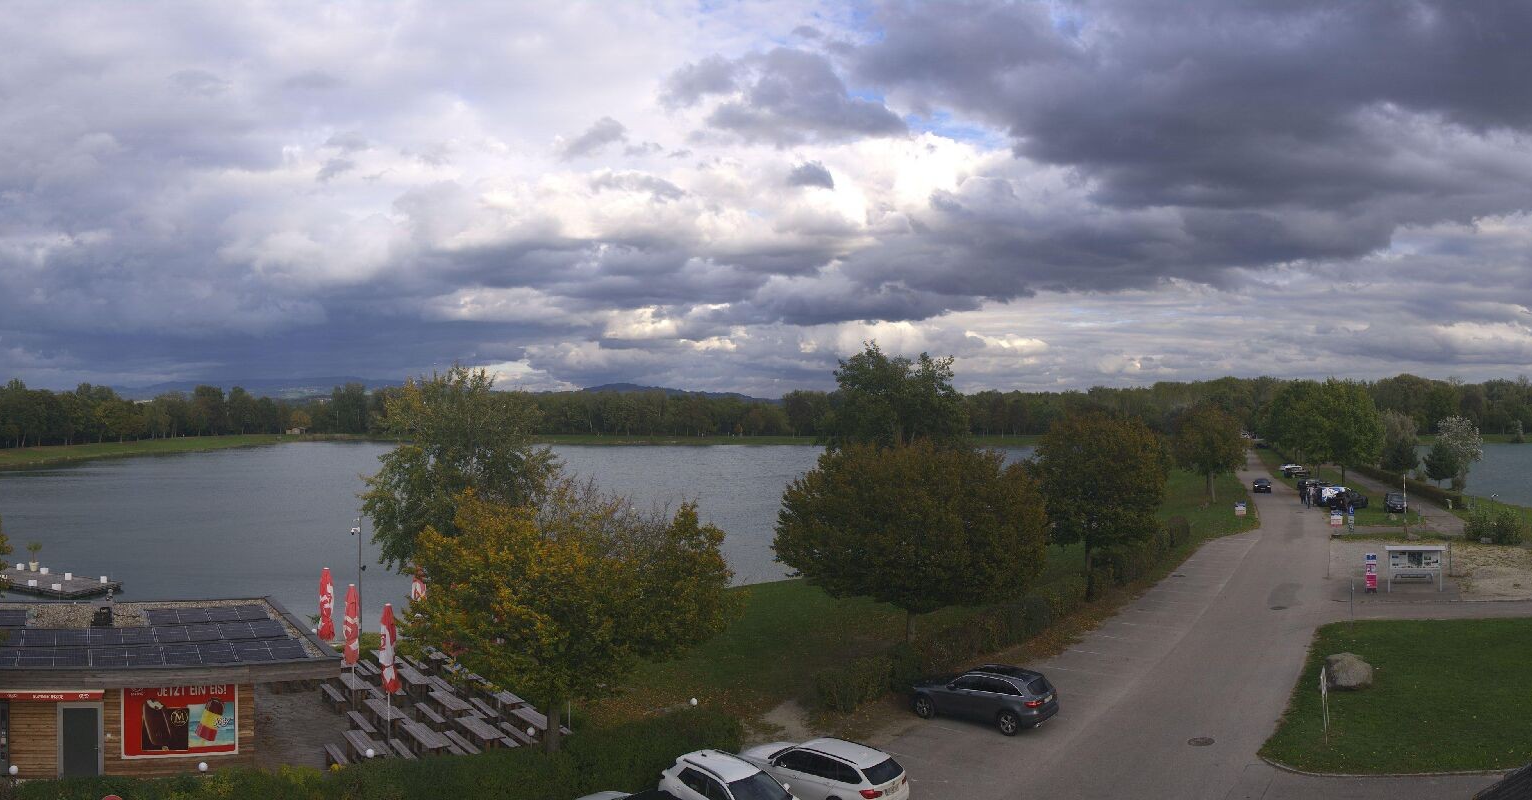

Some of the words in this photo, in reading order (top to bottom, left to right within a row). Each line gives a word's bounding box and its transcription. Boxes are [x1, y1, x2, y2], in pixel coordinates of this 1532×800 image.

[157, 686, 185, 697] JETZT
[189, 685, 206, 696] EIN
[210, 684, 227, 695] EIS!
